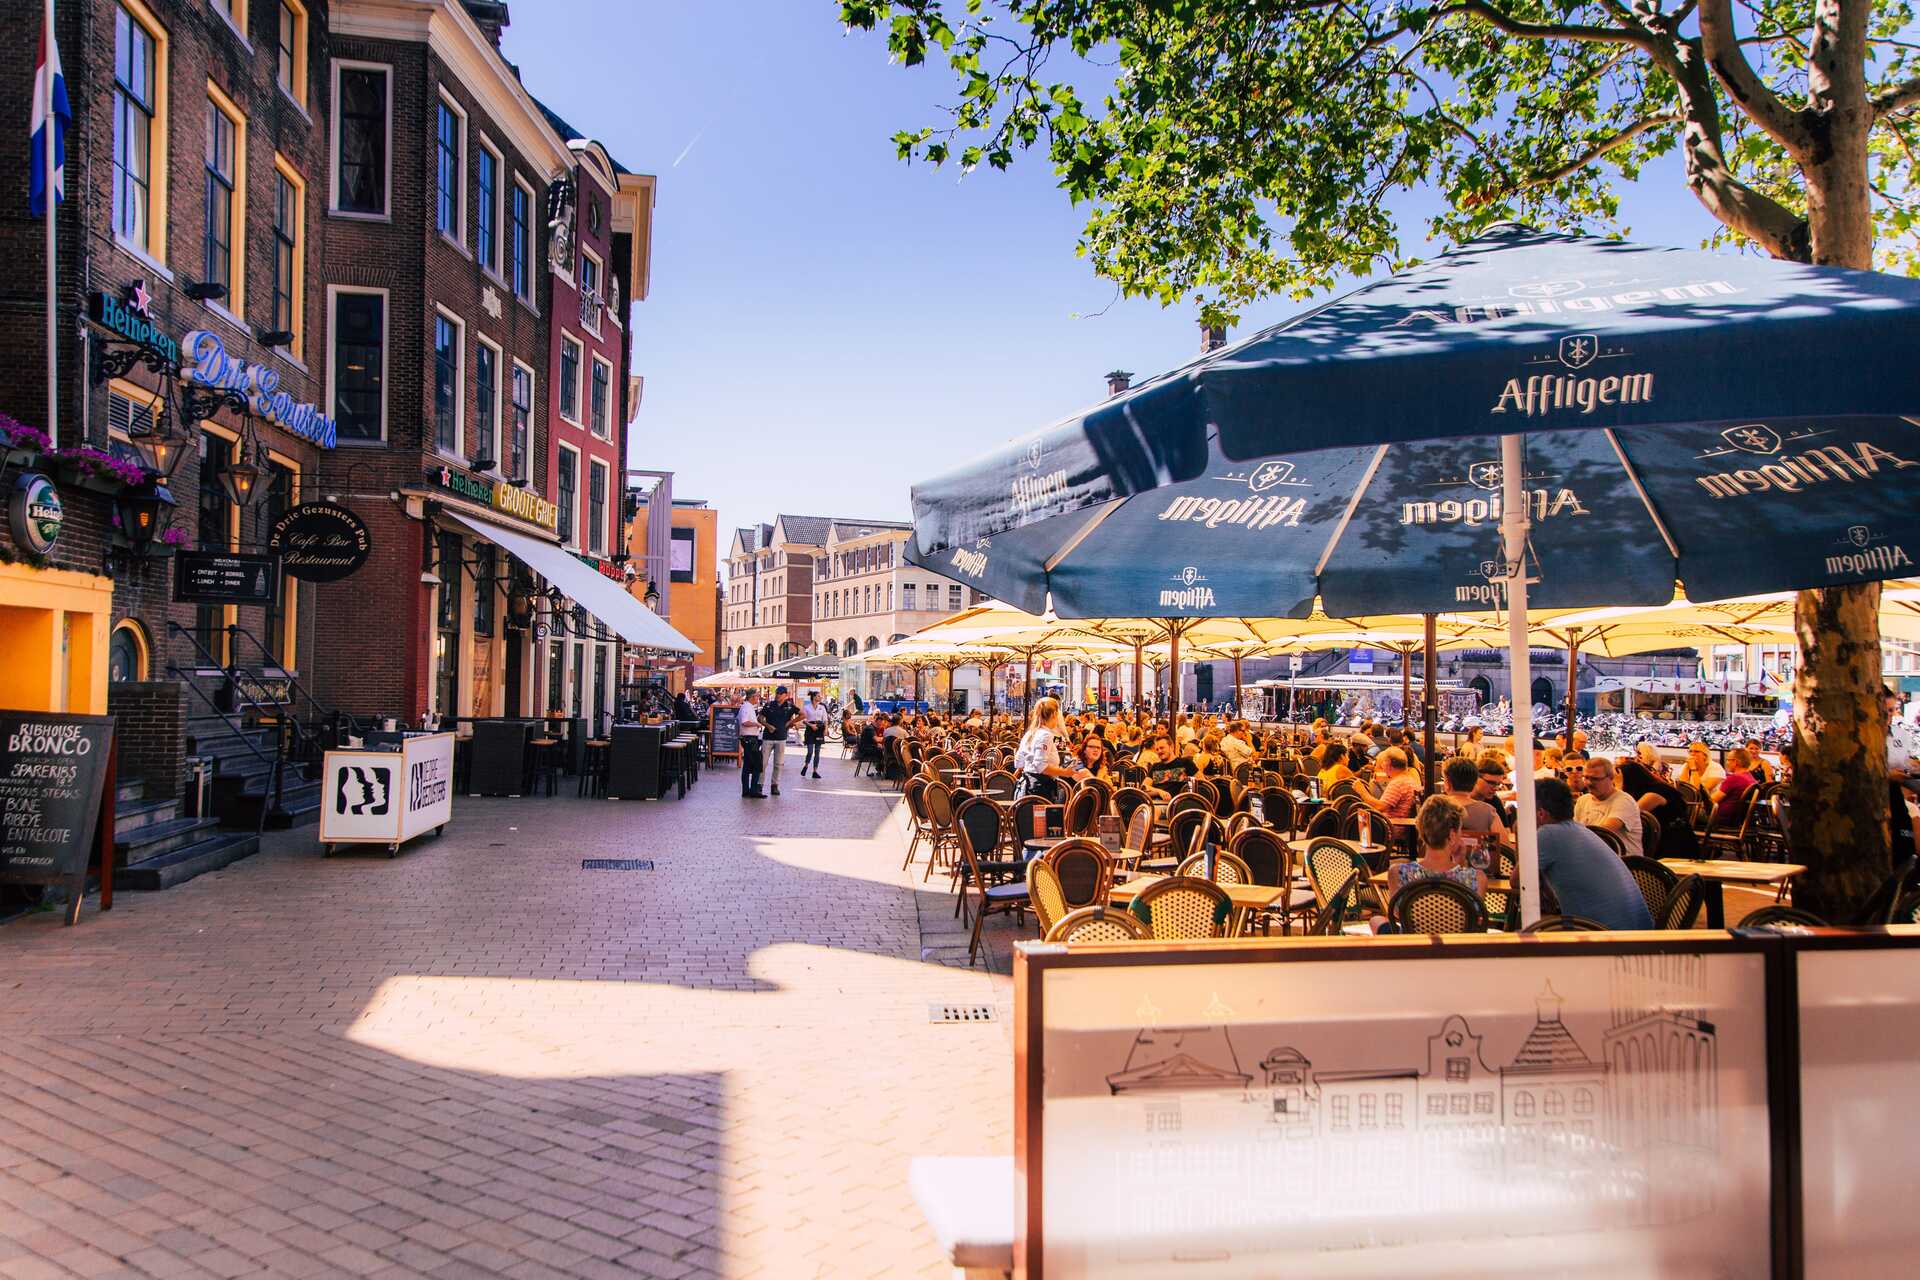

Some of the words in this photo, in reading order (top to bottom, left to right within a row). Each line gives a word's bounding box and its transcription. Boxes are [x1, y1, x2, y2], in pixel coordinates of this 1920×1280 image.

[101, 292, 177, 362] Heineken
[182, 330, 249, 394] Drie
[1490, 373, 1655, 417] Affligem
[1006, 469, 1069, 516] Affligem
[500, 483, 536, 520] GROOTE
[536, 497, 559, 529] GRIET
[275, 511, 299, 531] Drie
[302, 506, 357, 528] Gezusters
[270, 532, 281, 547] De
[355, 528, 368, 551] Pub
[282, 550, 356, 566] Restaurant
[19, 723, 82, 738] RIBHOUSE
[8, 735, 91, 755] BRONCO
[11, 764, 77, 779] SPARERIBS
[0, 786, 39, 798] FAMOUS
[42, 787, 82, 800] STEAKS
[3, 813, 43, 827] RIBEYE
[7, 827, 71, 843] ENTRECOTE
